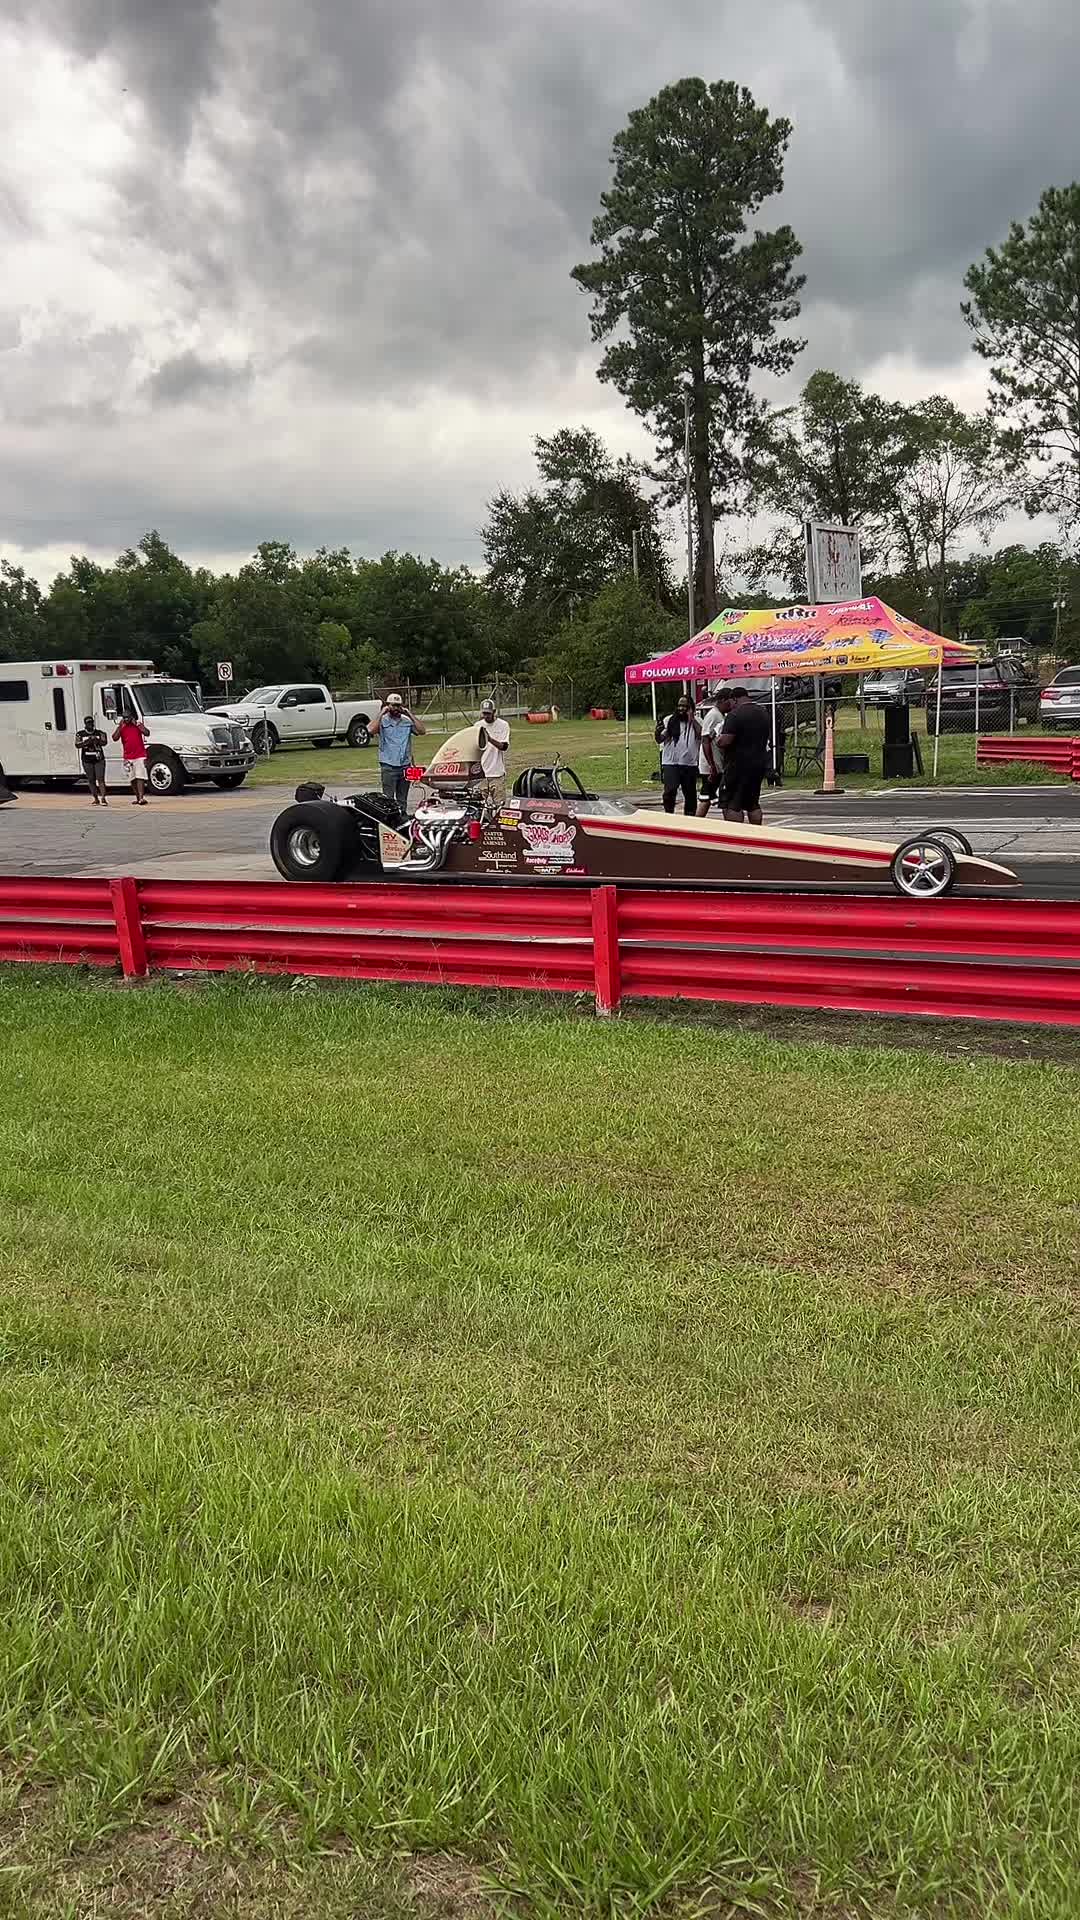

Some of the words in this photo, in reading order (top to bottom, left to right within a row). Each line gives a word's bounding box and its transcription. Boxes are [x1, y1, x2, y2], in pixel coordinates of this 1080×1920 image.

[642, 668, 676, 678] FOLLOW
[677, 666, 690, 676] US
[482, 851, 517, 859] Southland
